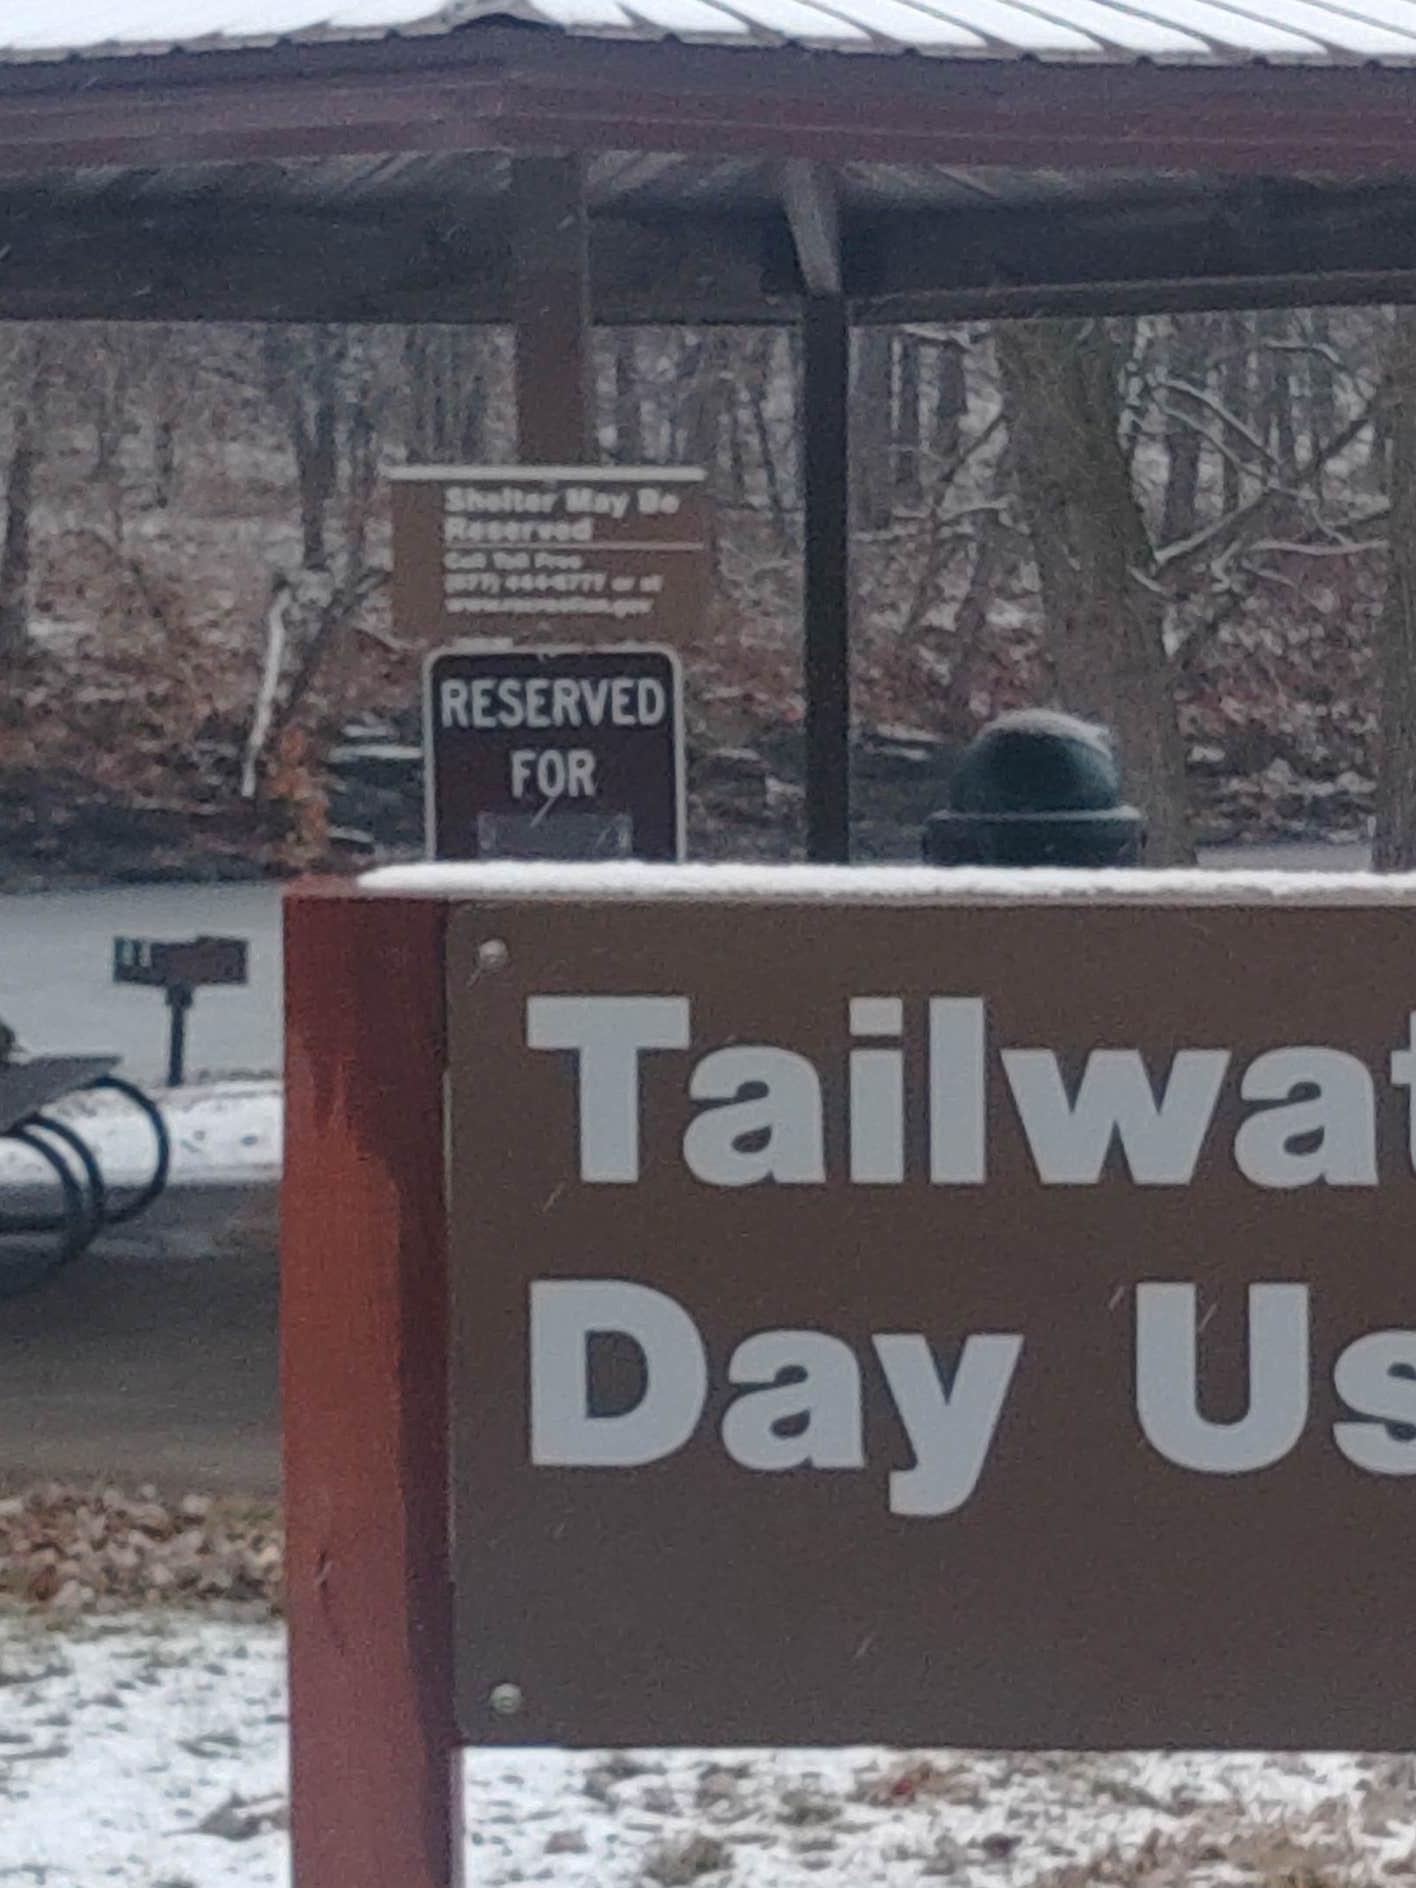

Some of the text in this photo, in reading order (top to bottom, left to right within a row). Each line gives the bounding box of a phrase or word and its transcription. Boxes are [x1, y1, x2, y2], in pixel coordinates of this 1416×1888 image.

[444, 486, 680, 518] Shelter May Be
[444, 517, 592, 542] Reserved
[440, 677, 666, 728] RESERVED
[510, 749, 596, 798] FOR
[532, 1281, 1022, 1514] Day
